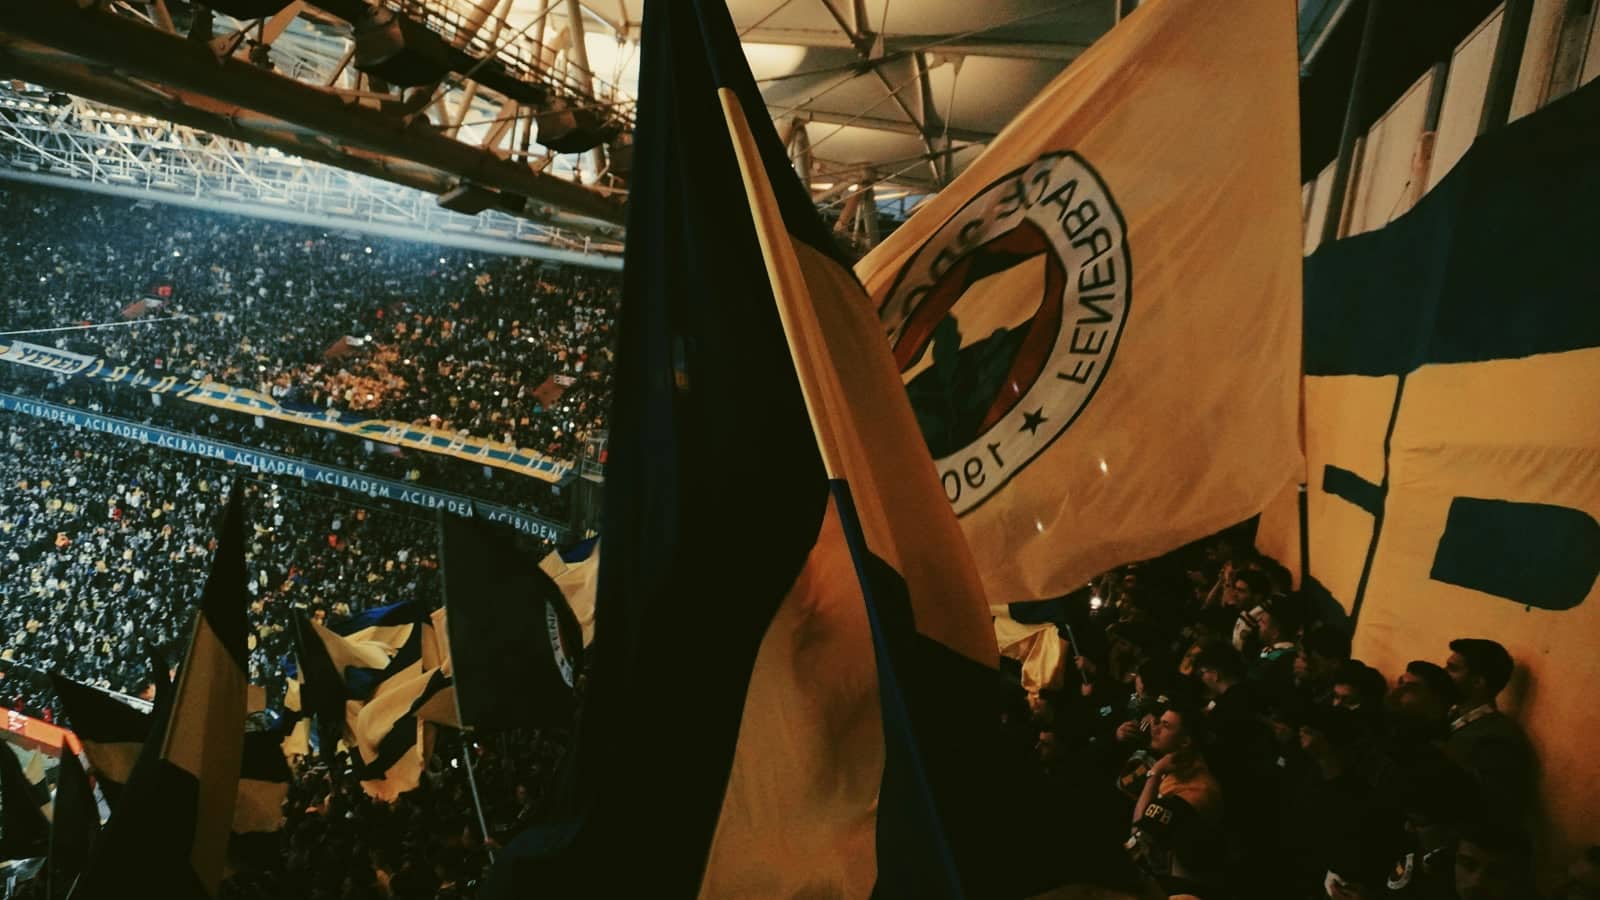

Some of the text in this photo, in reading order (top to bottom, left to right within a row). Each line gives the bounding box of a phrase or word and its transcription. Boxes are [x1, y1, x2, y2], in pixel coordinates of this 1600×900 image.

[19, 347, 83, 371] YETER
[14, 401, 76, 425] ACIBADEM
[84, 416, 149, 443] ACIBADEM
[157, 433, 226, 461] ACIBADEM
[234, 452, 305, 478] ACIBADEM
[314, 470, 391, 498] ACIBADEM
[488, 510, 558, 541] ACIBADEM
